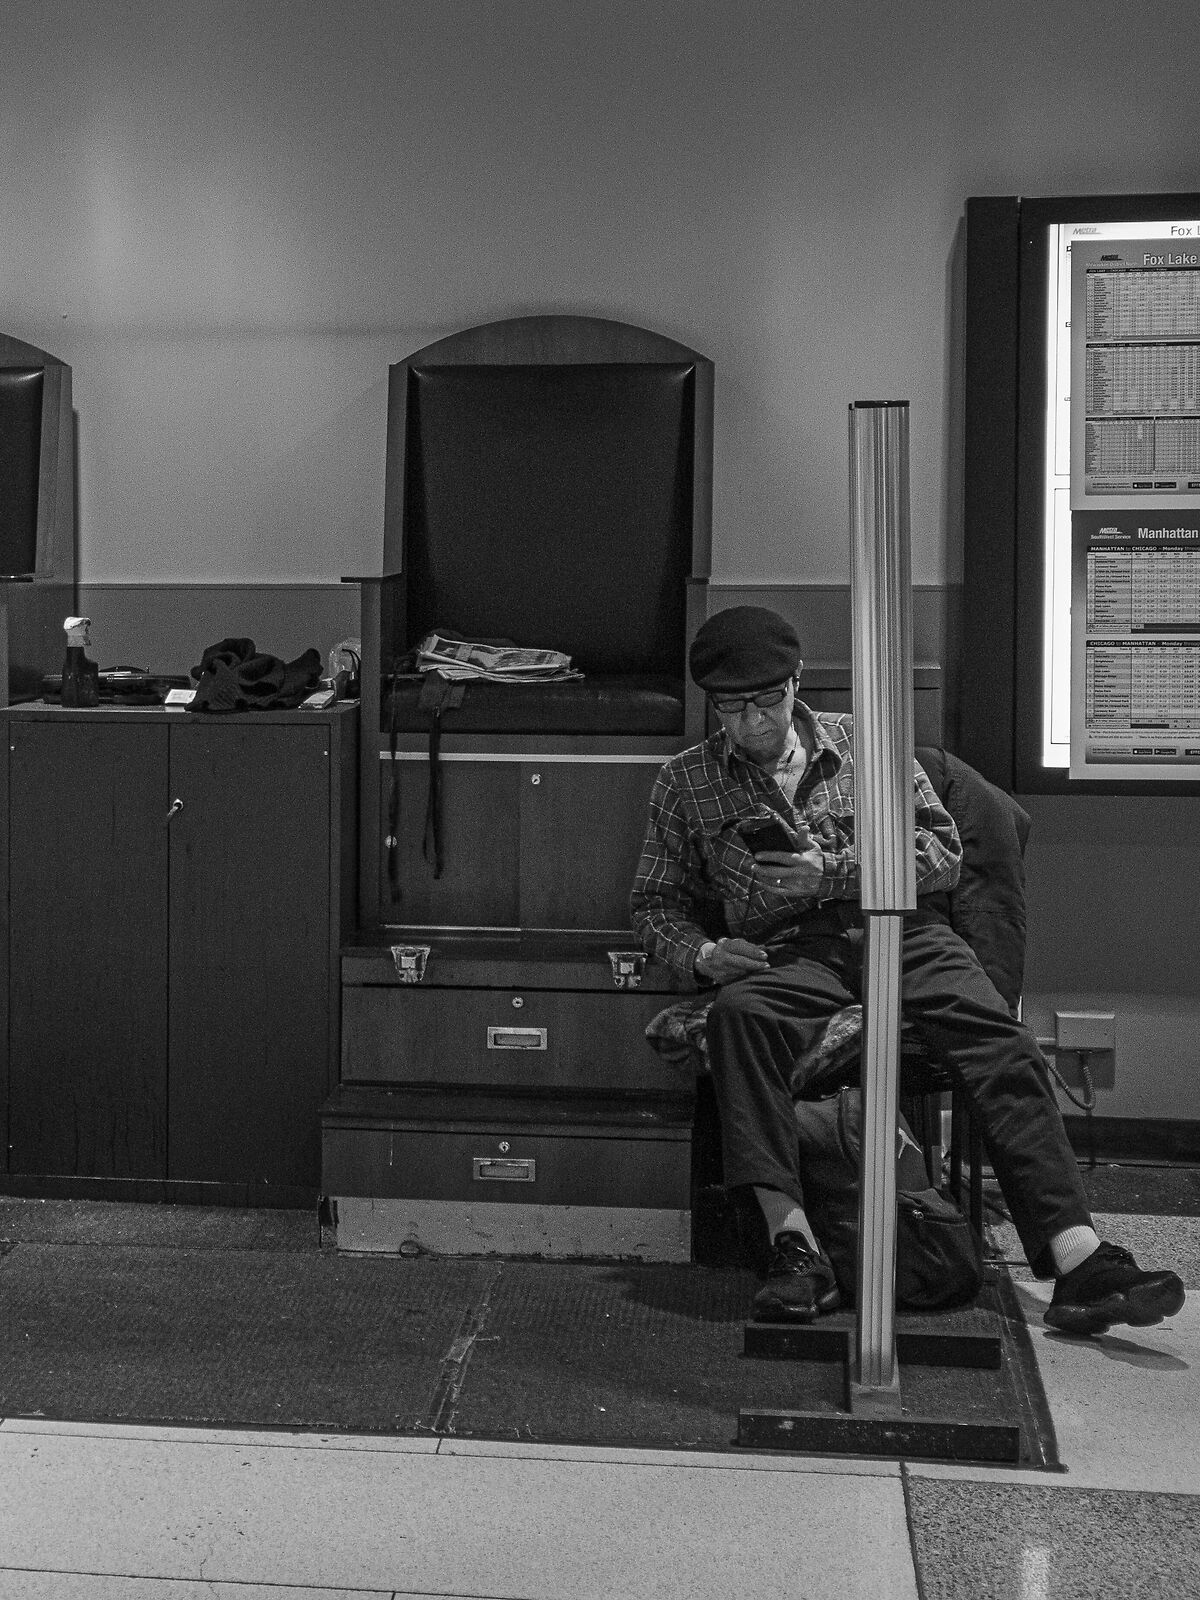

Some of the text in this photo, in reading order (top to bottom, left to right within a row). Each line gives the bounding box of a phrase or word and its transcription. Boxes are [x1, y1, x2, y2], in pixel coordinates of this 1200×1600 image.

[1171, 226, 1193, 236] Fox
[1143, 253, 1165, 266] Fox
[1168, 252, 1198, 265] Lake
[1138, 527, 1199, 539] Manhattan
